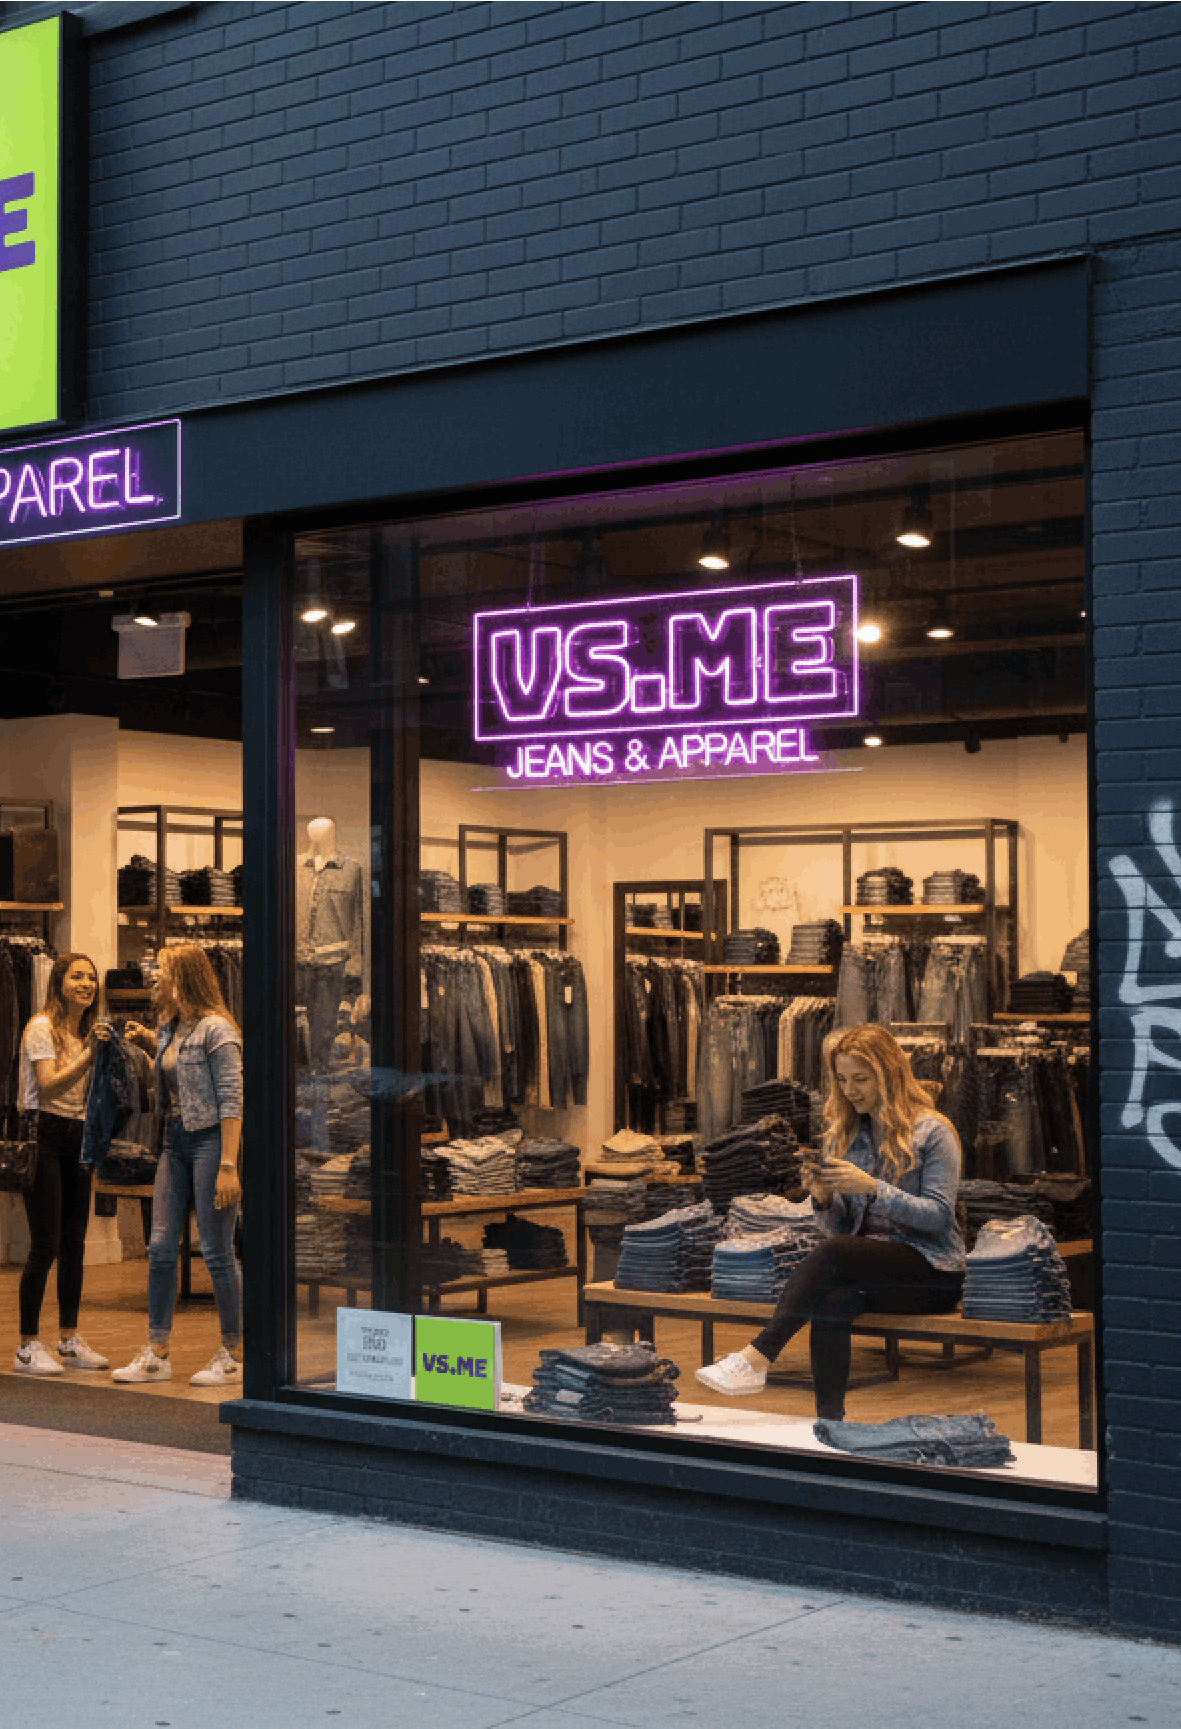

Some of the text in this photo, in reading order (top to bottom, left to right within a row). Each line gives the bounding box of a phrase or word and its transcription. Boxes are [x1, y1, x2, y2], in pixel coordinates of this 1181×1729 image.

[491, 600, 838, 722] VS.ME
[506, 727, 820, 779] JEANS & APPAREL
[422, 1352, 488, 1378] VS.ME
